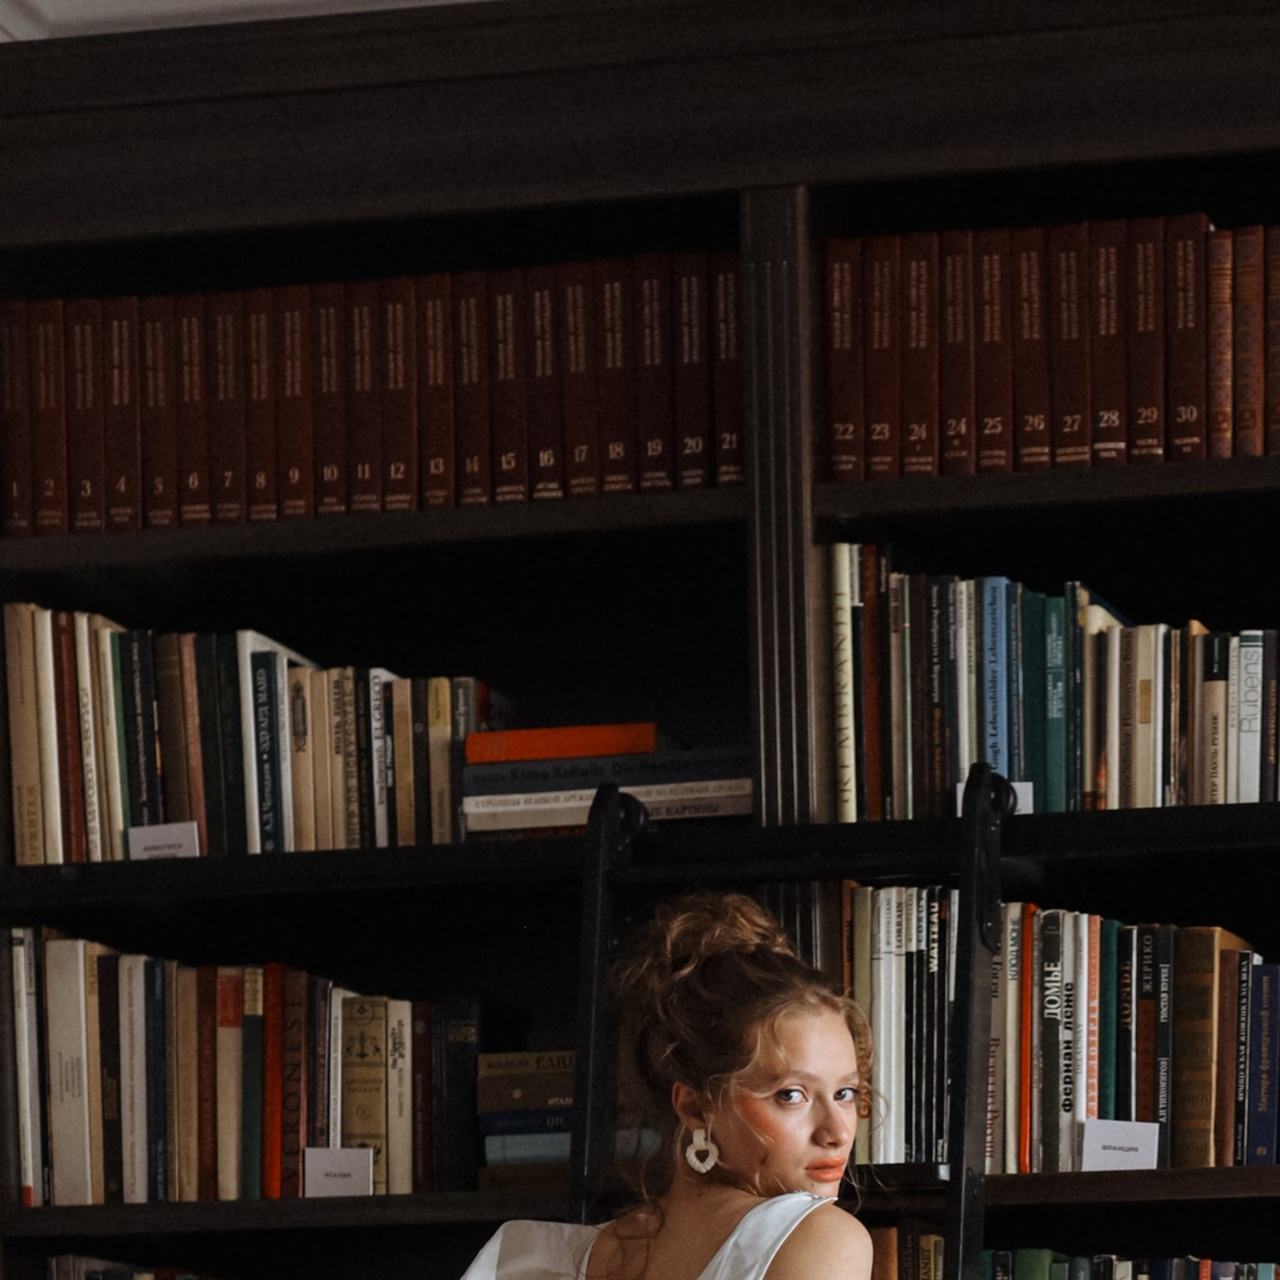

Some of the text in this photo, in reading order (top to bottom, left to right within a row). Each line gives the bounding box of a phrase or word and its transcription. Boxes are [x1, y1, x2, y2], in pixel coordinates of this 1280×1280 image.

[1024, 413, 1044, 433] 26
[1063, 412, 1082, 432] 27
[1099, 408, 1120, 428] 28
[1138, 405, 1158, 425] 29
[1176, 404, 1197, 424] 30
[834, 423, 853, 441] 22
[871, 422, 889, 441] 23
[947, 415, 966, 436] 24
[983, 415, 1002, 435] 25
[608, 440, 625, 460] 18
[646, 437, 663, 457] 19
[683, 436, 704, 455] 20
[721, 432, 738, 450] 21
[501, 452, 516, 470] 15
[538, 448, 554, 468] 16
[574, 444, 588, 463] 17
[322, 463, 339, 481] 10
[356, 463, 372, 481] 11
[390, 461, 405, 480] 12
[985, 586, 1001, 770] Gogh Lebensbilder Lebenszeichen
[1239, 649, 1260, 733] Rubens
[895, 900, 904, 949] LORRAIN
[928, 902, 940, 974] WATTEAU
[1009, 916, 1019, 981] КЛОД МОНЕ
[1143, 934, 1154, 994] ЖЕРИКО
[1043, 962, 1061, 1020] ДОМЬЕ
[1062, 982, 1074, 1112] фернан леже
